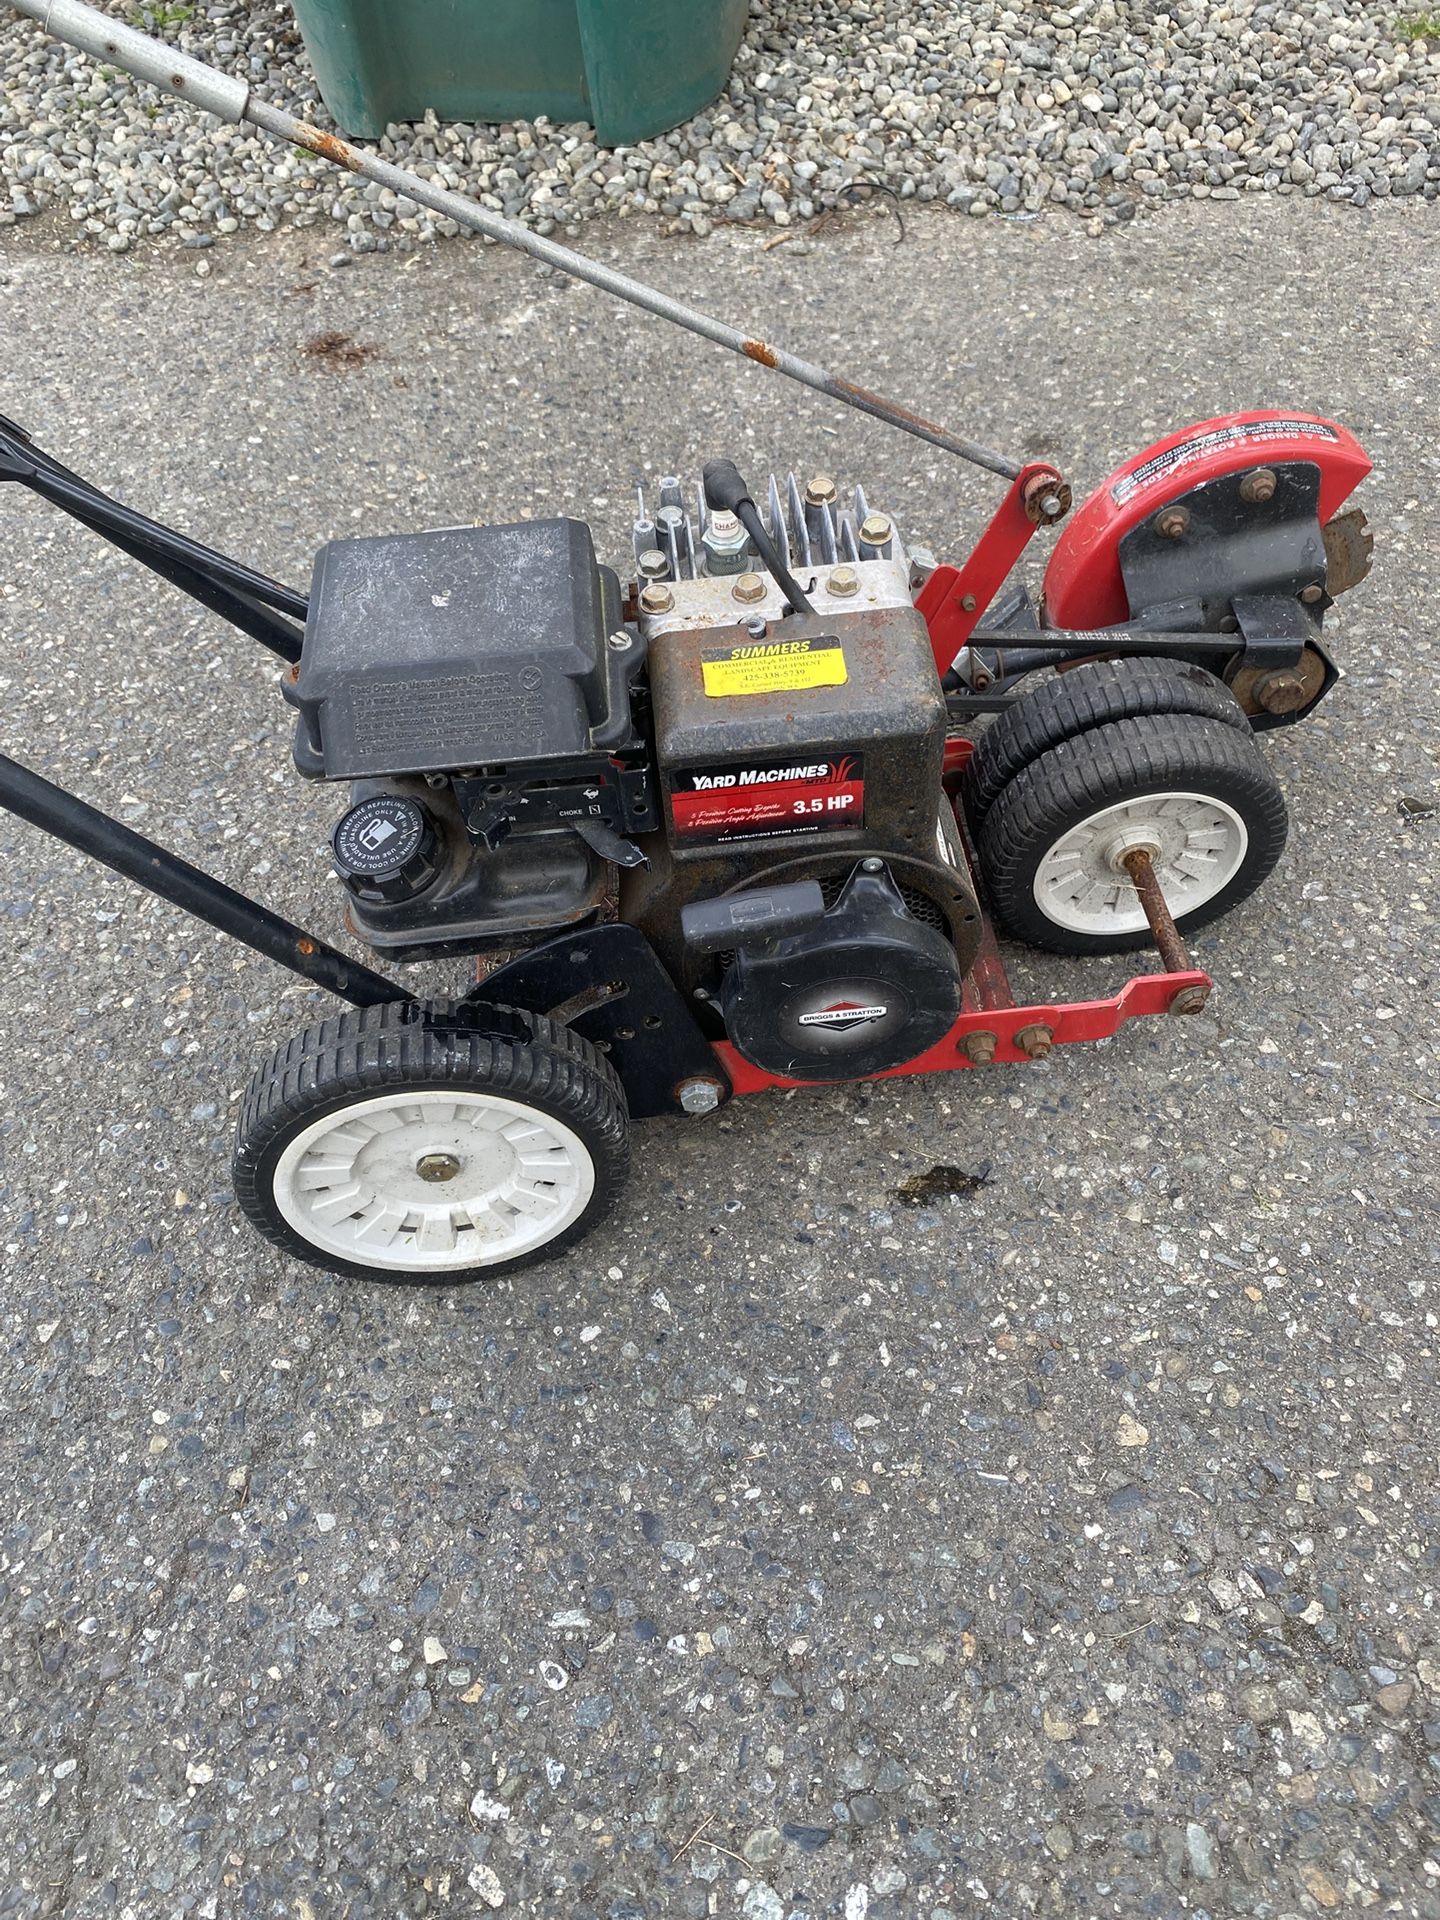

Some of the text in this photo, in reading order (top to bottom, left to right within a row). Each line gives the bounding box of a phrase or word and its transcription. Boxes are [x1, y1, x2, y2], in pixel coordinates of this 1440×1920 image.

[1252, 433, 1298, 442] DANGER
[1181, 442, 1235, 466] ROTATING
[1141, 466, 1172, 488] LADE
[714, 520, 738, 529] CHAM
[730, 640, 810, 660] SUMMERS
[712, 660, 768, 670] COMMERCIAL
[778, 652, 832, 661] RESIDENTIAL
[724, 660, 821, 675] LANDSCAPE EQUIPMENT
[743, 669, 805, 681] 425-338-5739
[692, 764, 828, 791] YARD MACHINES
[367, 801, 406, 810] REFUELING
[793, 794, 854, 814] 3.5 HP
[344, 807, 365, 830] BEFORE
[699, 810, 726, 818] Position
[349, 813, 373, 841] GASOLINE
[349, 842, 380, 860] UNLEADED
[382, 848, 396, 858] USE
[400, 833, 418, 855] ENGINE
[842, 1009, 882, 1017] STRATTON
